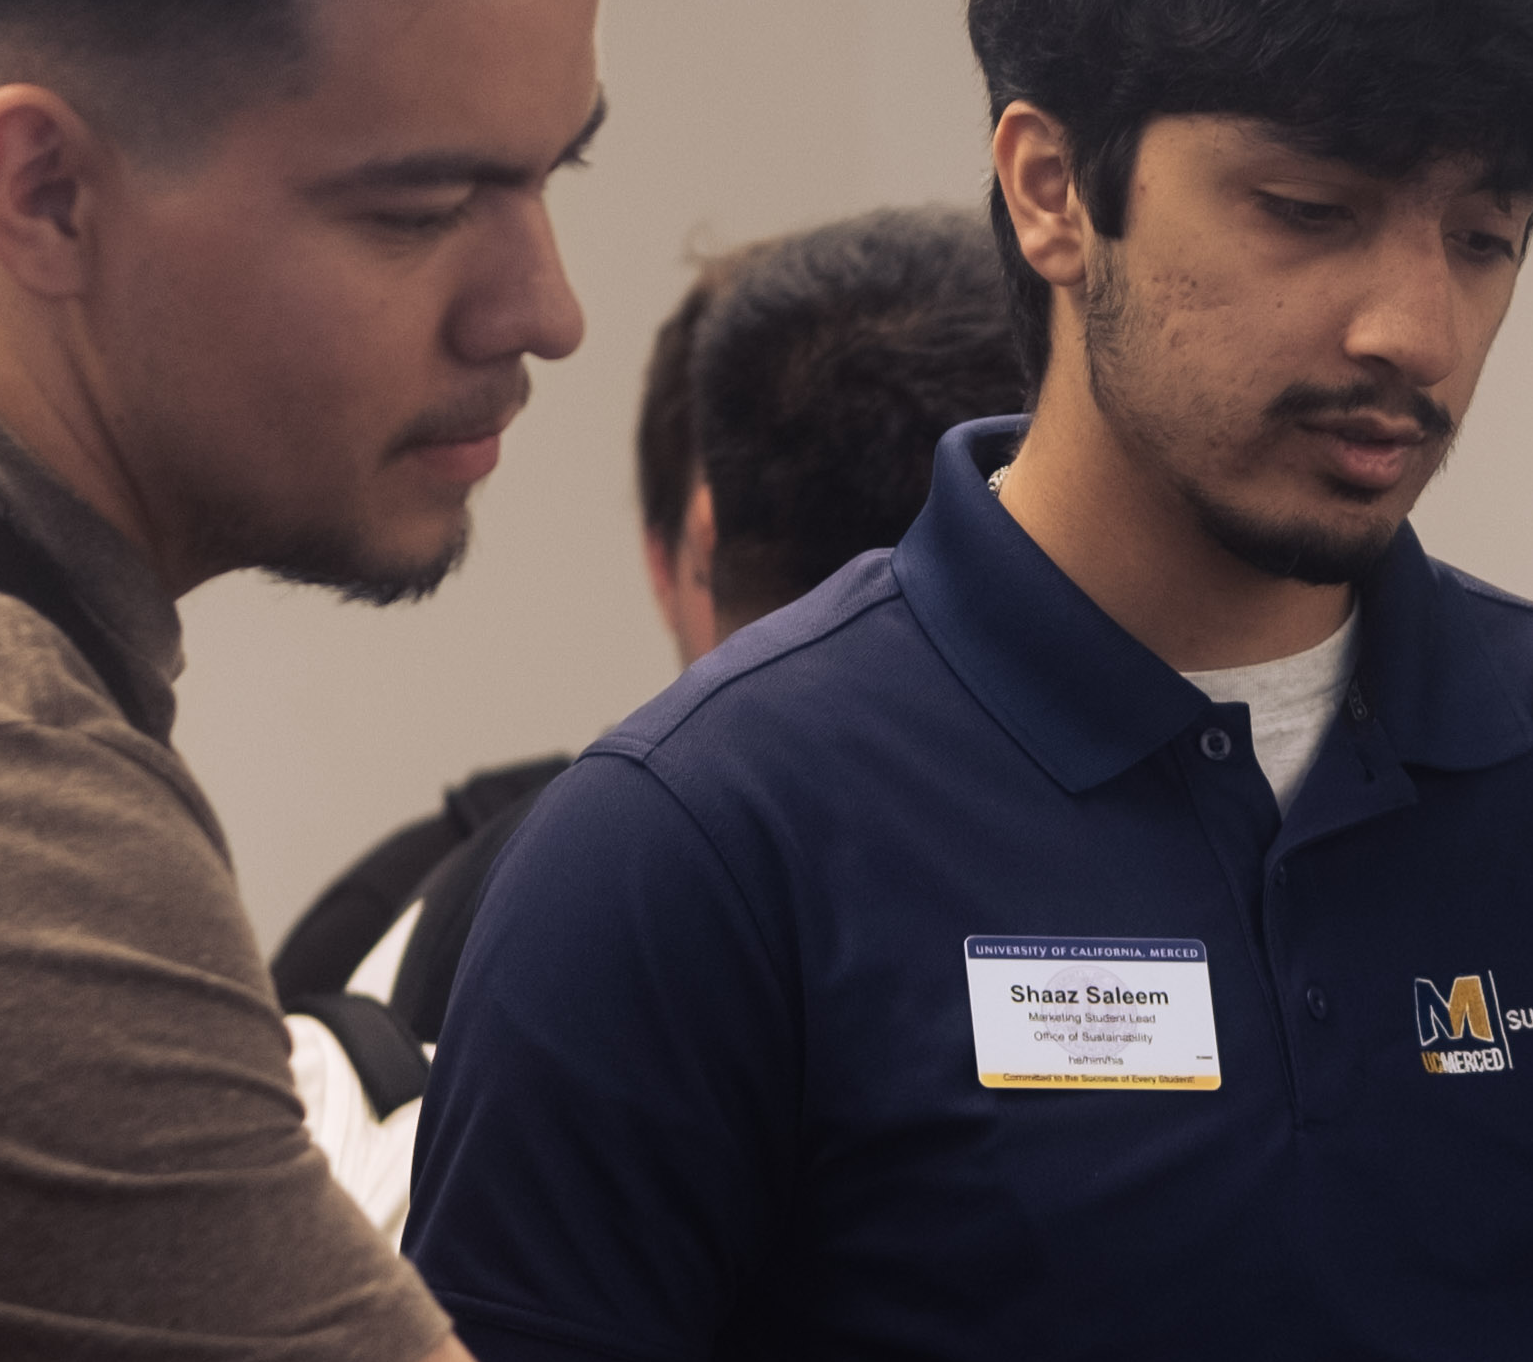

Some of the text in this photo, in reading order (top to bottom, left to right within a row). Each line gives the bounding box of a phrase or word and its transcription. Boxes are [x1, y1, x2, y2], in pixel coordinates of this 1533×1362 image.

[975, 944, 1047, 958] UNIVERSITY
[1051, 947, 1067, 956] OF
[1149, 948, 1199, 959] MERCED
[1010, 984, 1169, 1005] Shaaz Saleem
[1028, 1012, 1156, 1024] Marketing Student Lead
[1414, 975, 1495, 1047] M
[1033, 1031, 1153, 1045] Office of Sustainability
[1003, 1073, 1052, 1082] Committed
[1054, 1074, 1063, 1082] to
[1064, 1074, 1079, 1083] the
[1081, 1074, 1118, 1083] Success
[1121, 1075, 1130, 1083] of
[1132, 1075, 1157, 1084] Every
